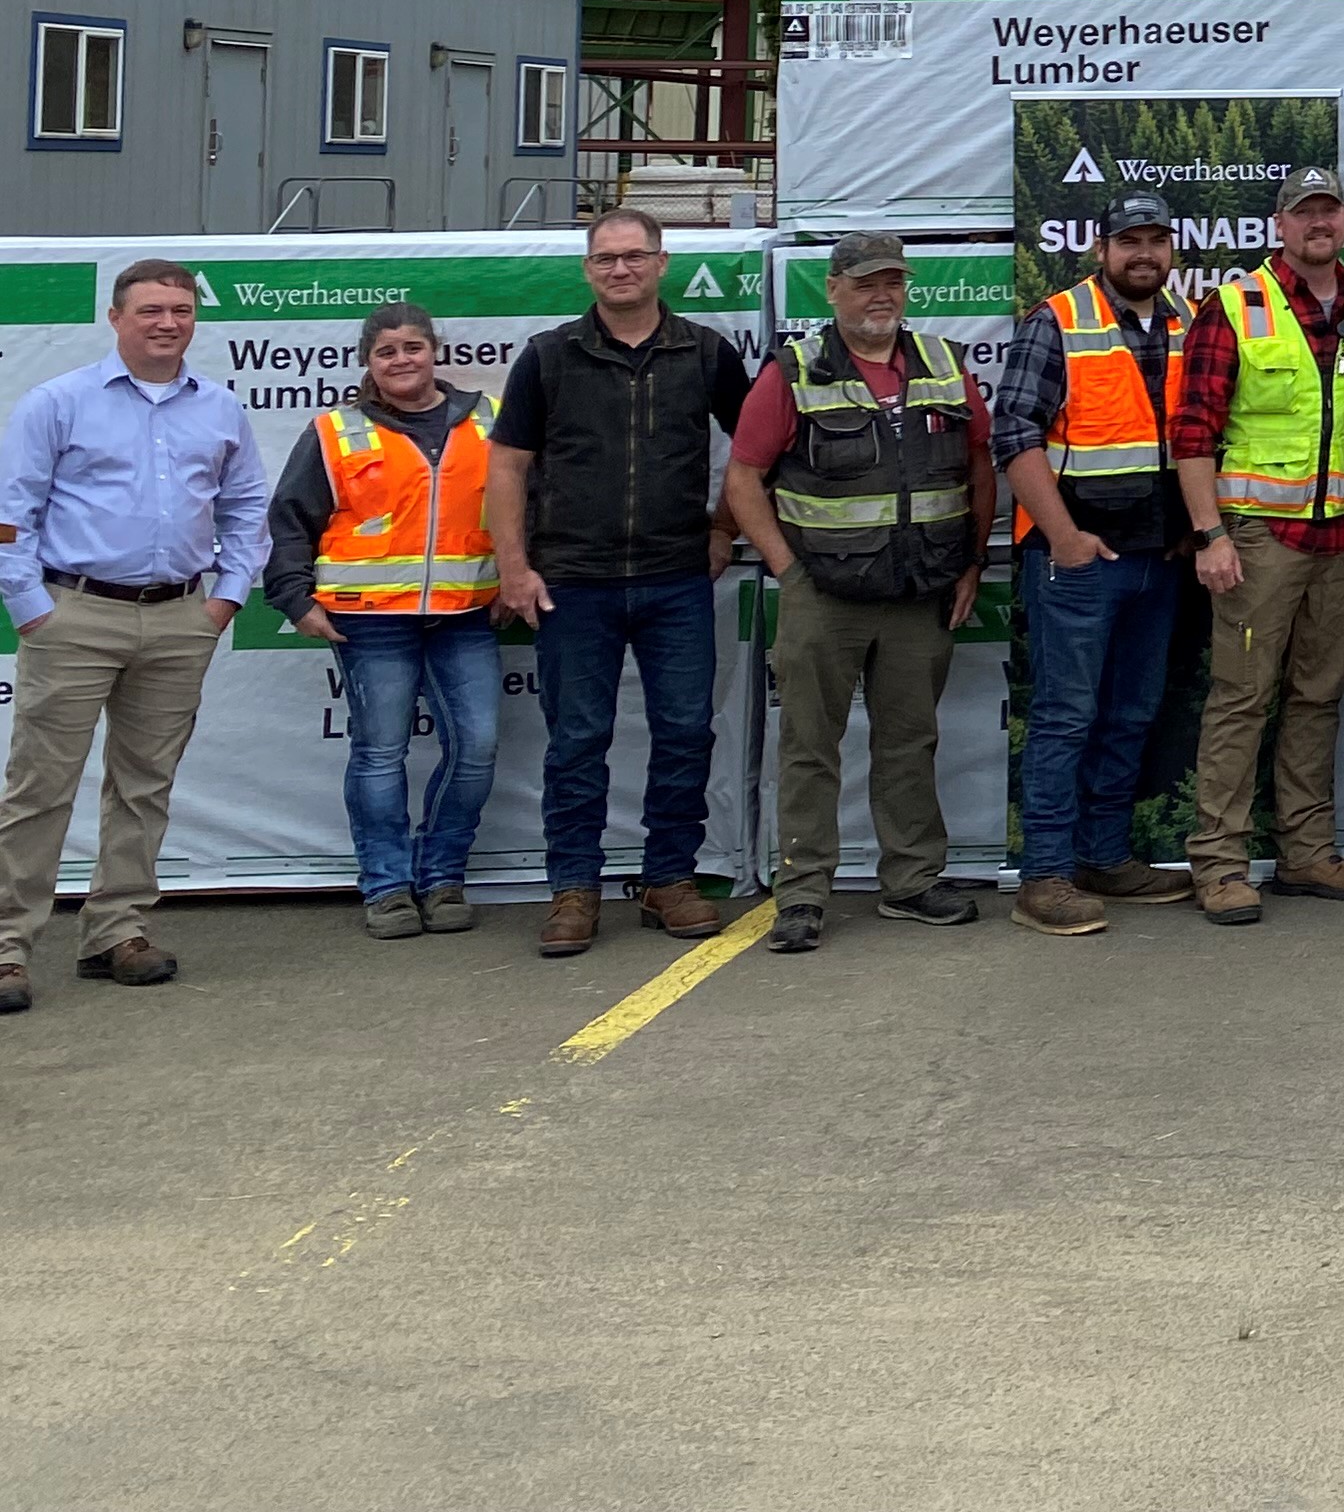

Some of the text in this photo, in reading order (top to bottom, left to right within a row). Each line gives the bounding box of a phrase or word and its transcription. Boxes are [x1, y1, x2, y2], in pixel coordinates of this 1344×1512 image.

[992, 15, 1270, 53] Weyerhaeuser
[992, 55, 1141, 85] Lumber
[1116, 157, 1291, 188] Weyerhaeuser
[233, 281, 410, 312] Weyerhaeuser
[228, 340, 515, 376] Weyeruser
